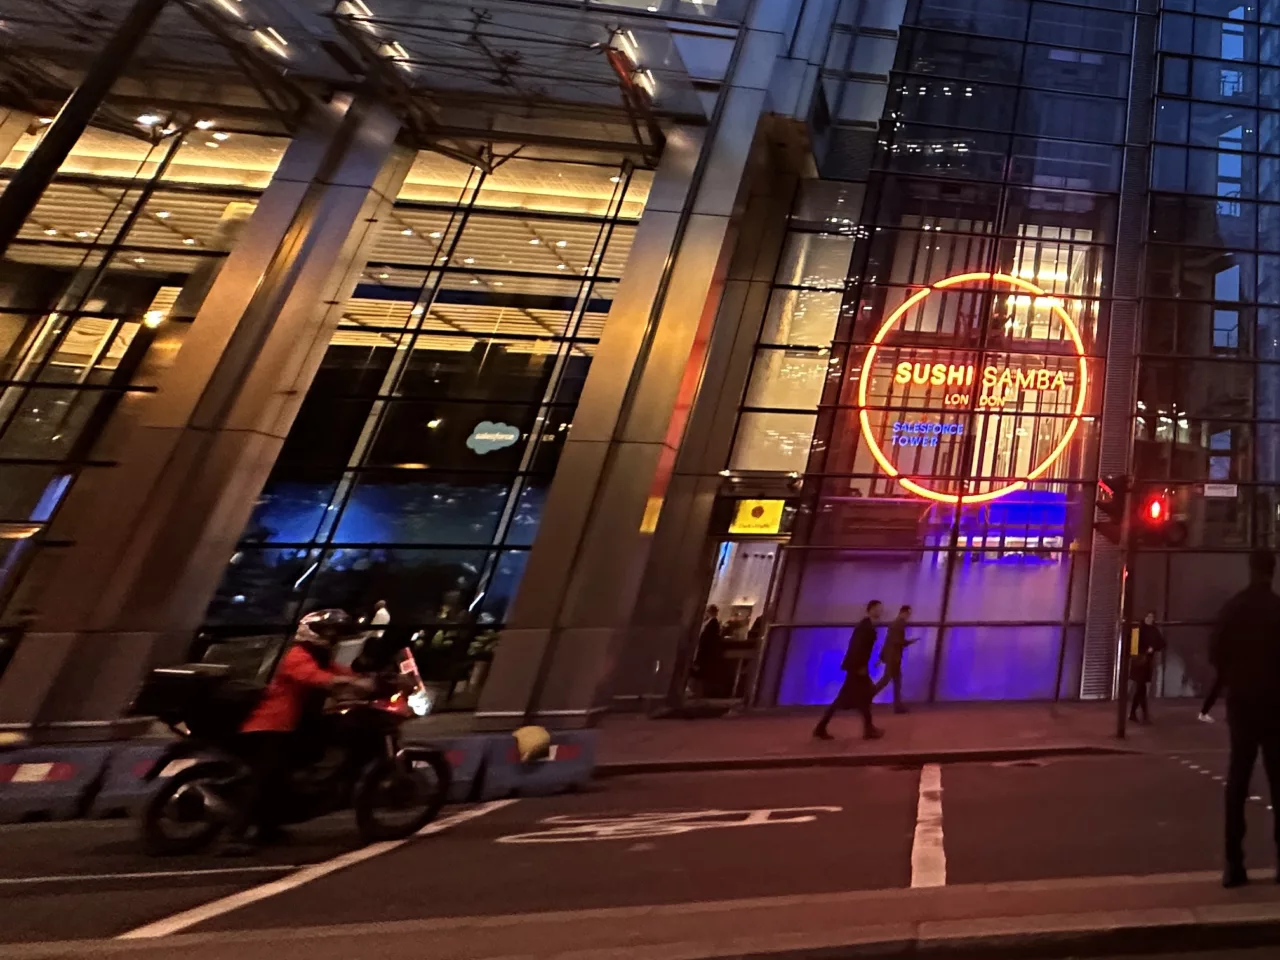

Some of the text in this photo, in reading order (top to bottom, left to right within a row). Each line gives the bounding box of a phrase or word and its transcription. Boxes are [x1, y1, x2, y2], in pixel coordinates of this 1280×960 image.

[895, 361, 1066, 391] SUSHI SAMBA
[892, 421, 964, 436] SALESFORCE
[891, 434, 938, 447] TOWER
